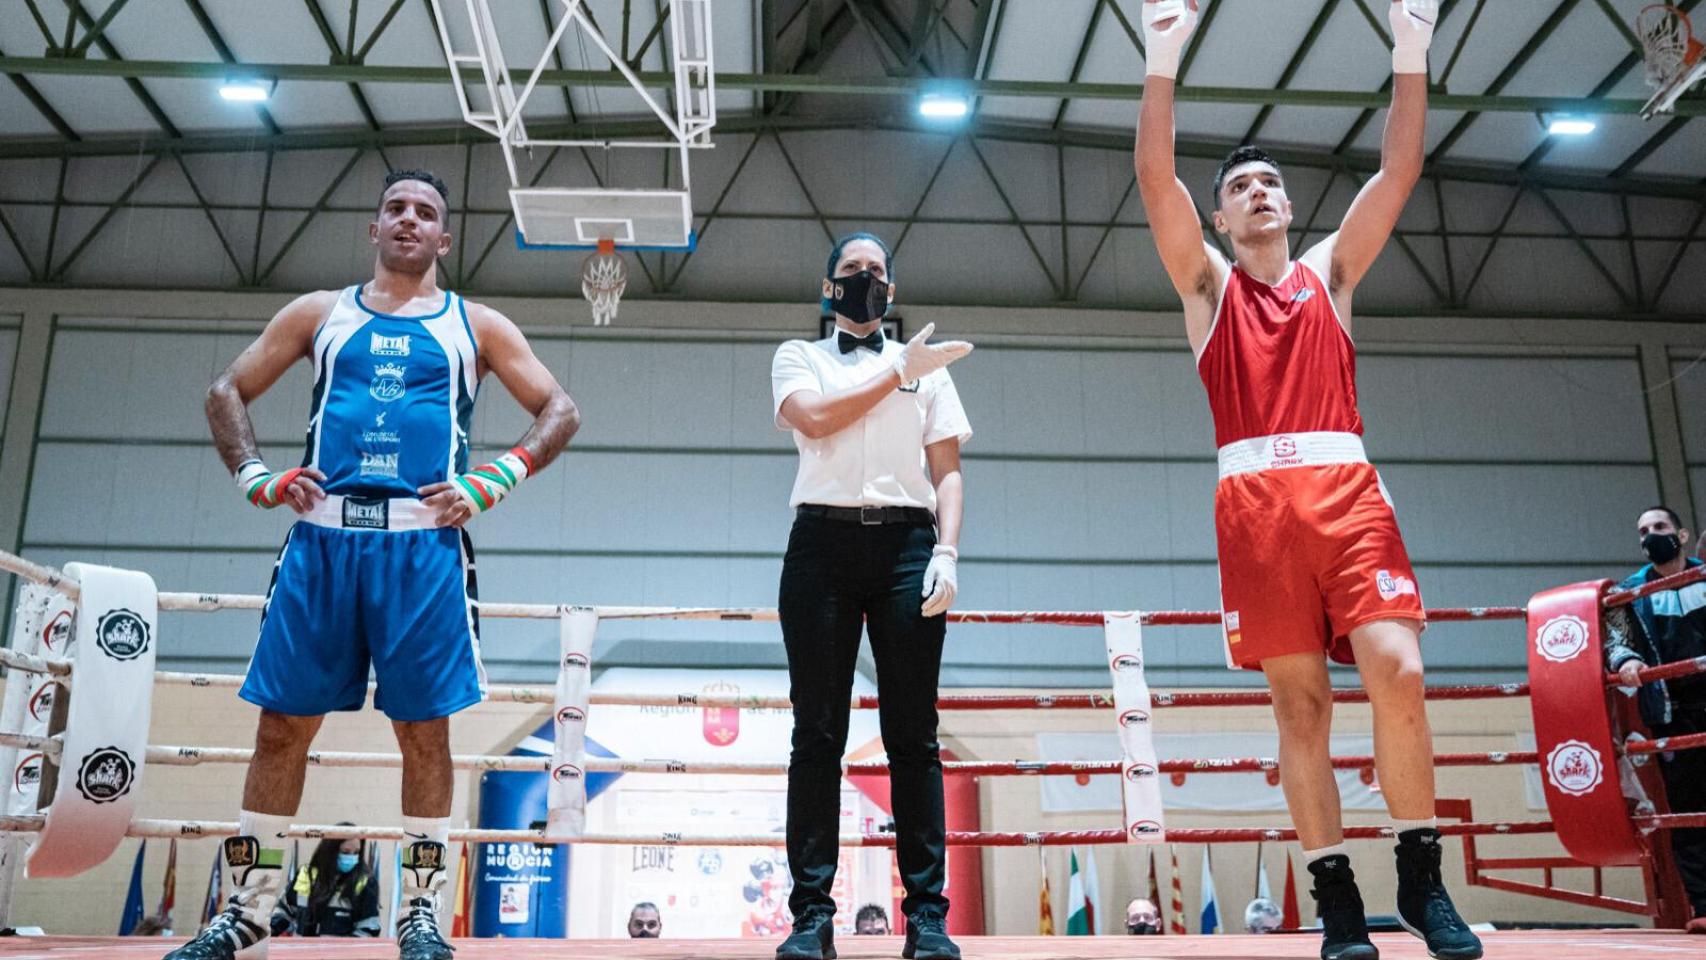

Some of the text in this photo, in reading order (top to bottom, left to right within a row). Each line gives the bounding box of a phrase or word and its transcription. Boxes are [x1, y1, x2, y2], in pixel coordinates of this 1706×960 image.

[371, 332, 410, 352] METAL
[346, 500, 386, 521] METAL
[678, 694, 698, 704] KING
[667, 763, 687, 773] KING
[632, 847, 676, 872] LEONE
